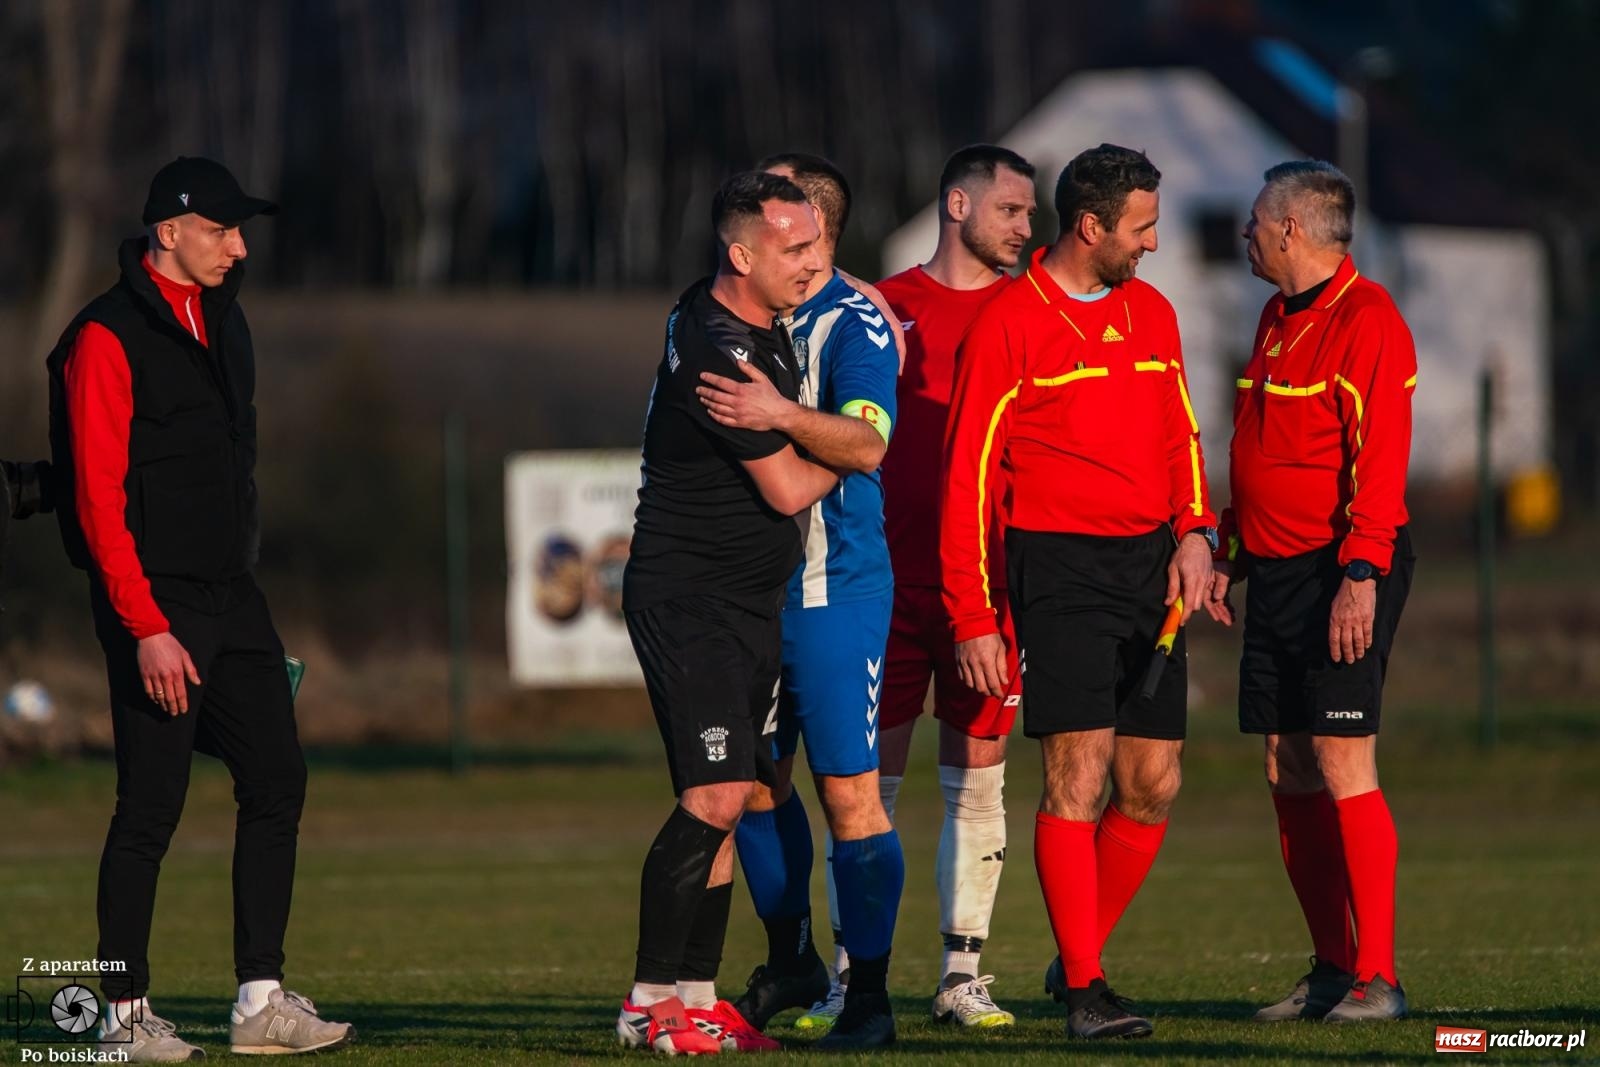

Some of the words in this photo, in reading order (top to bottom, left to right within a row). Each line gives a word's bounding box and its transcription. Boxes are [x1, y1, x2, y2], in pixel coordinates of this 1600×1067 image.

[862, 405, 878, 425] C
[708, 746, 725, 755] KS
[266, 1015, 297, 1043] N
